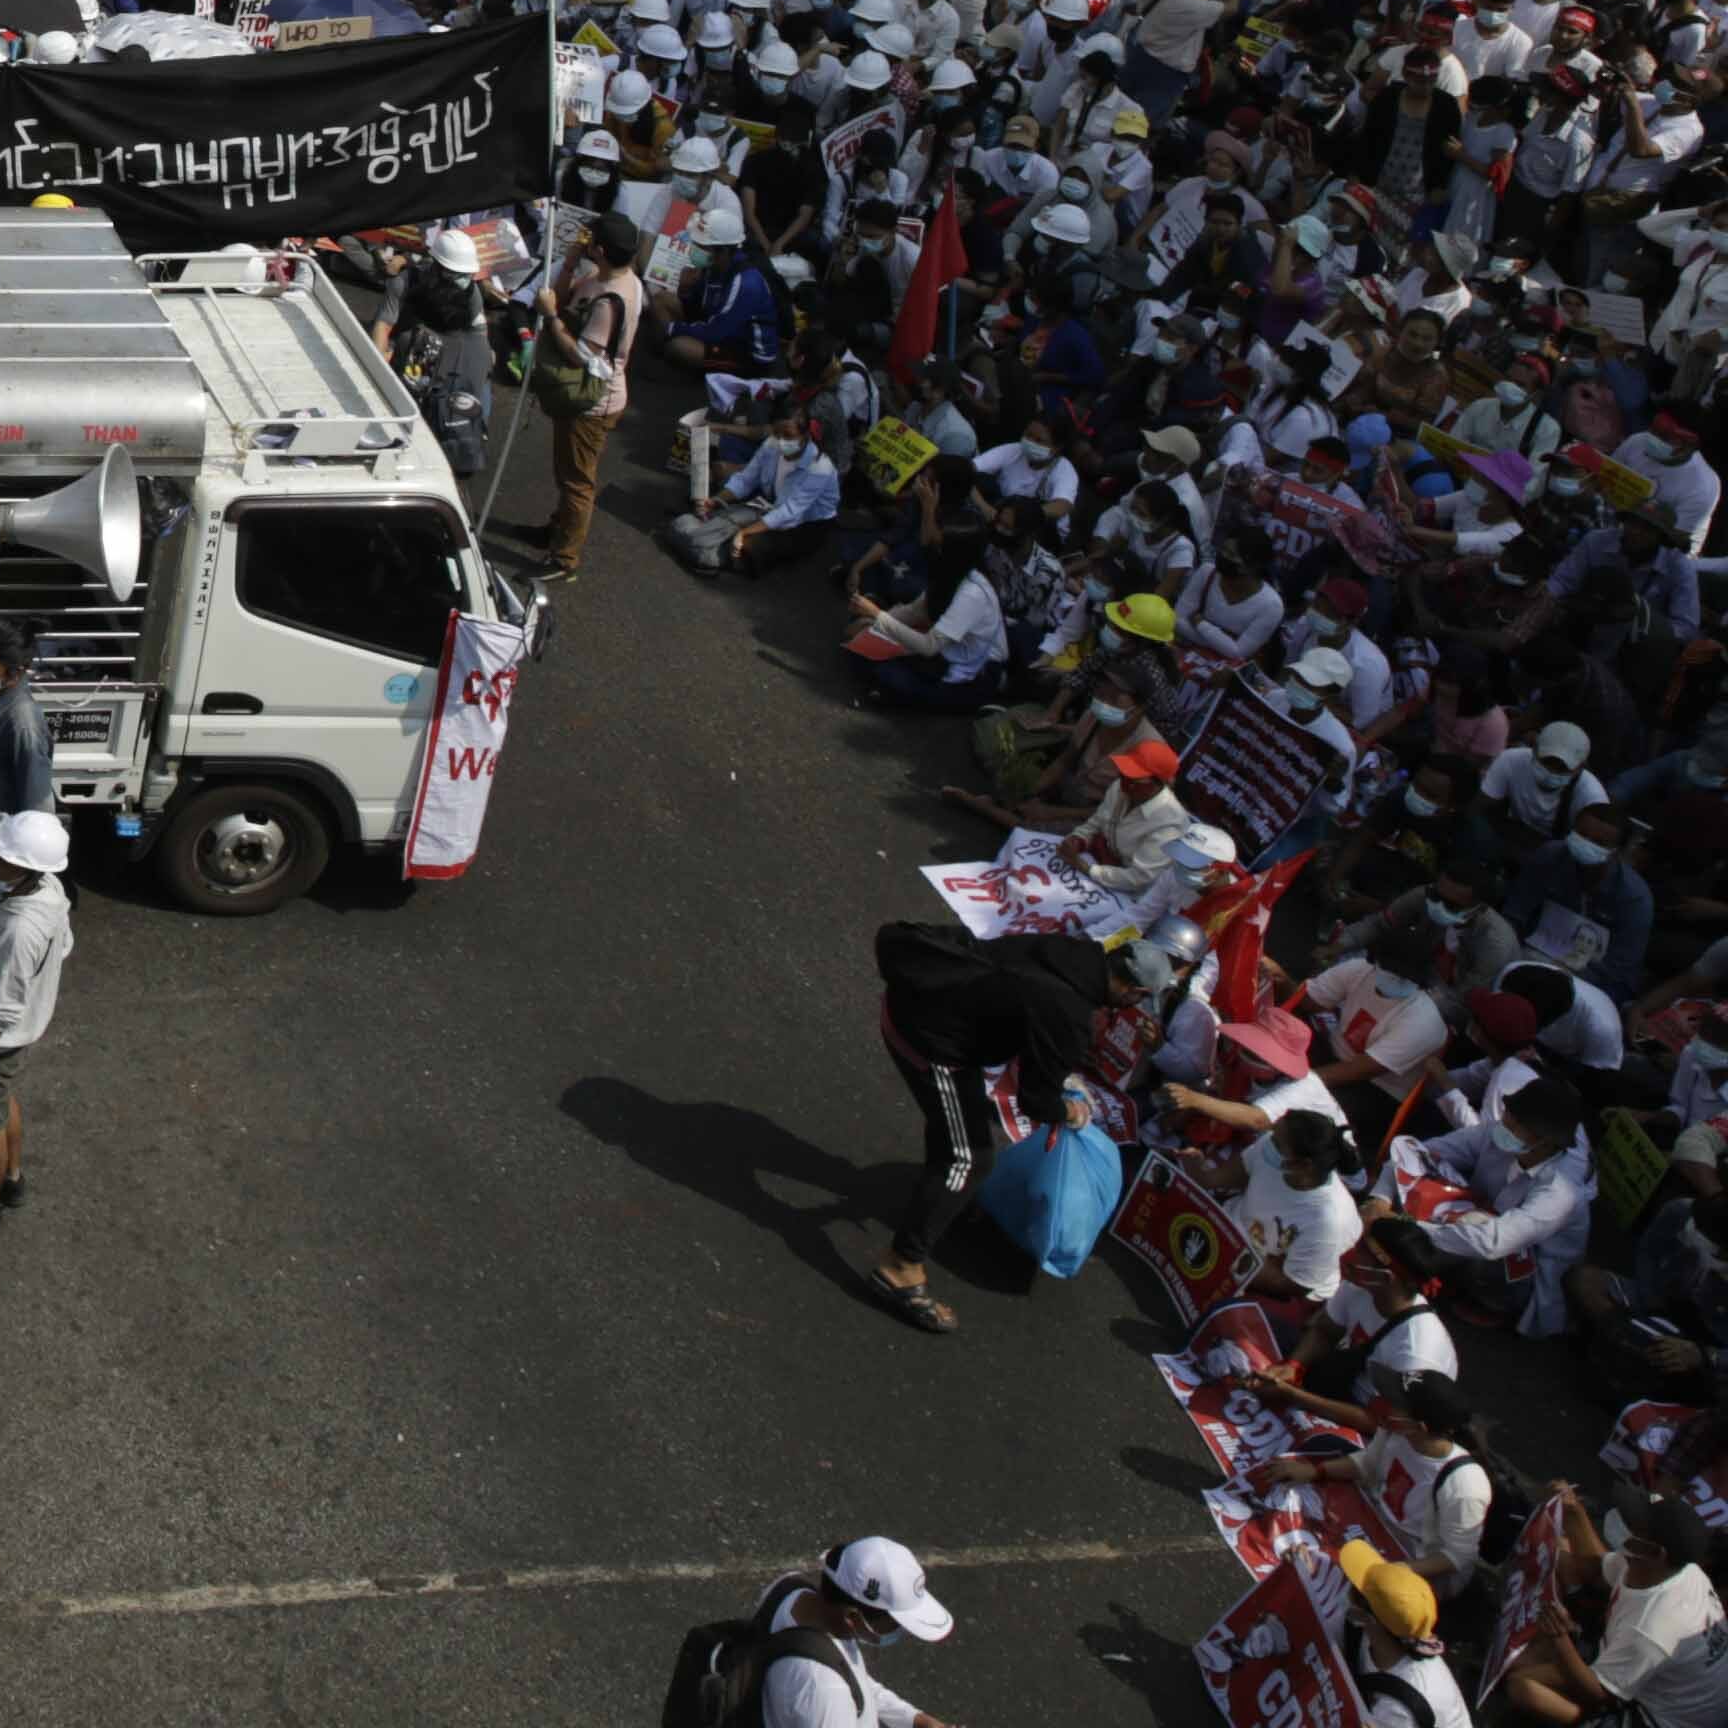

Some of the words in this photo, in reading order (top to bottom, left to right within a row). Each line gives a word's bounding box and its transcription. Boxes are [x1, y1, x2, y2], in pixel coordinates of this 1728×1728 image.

[285, 23, 319, 43] WHO
[329, 20, 353, 37] DO
[82, 424, 138, 442] THAN
[1132, 1233, 1165, 1271] SAVE
